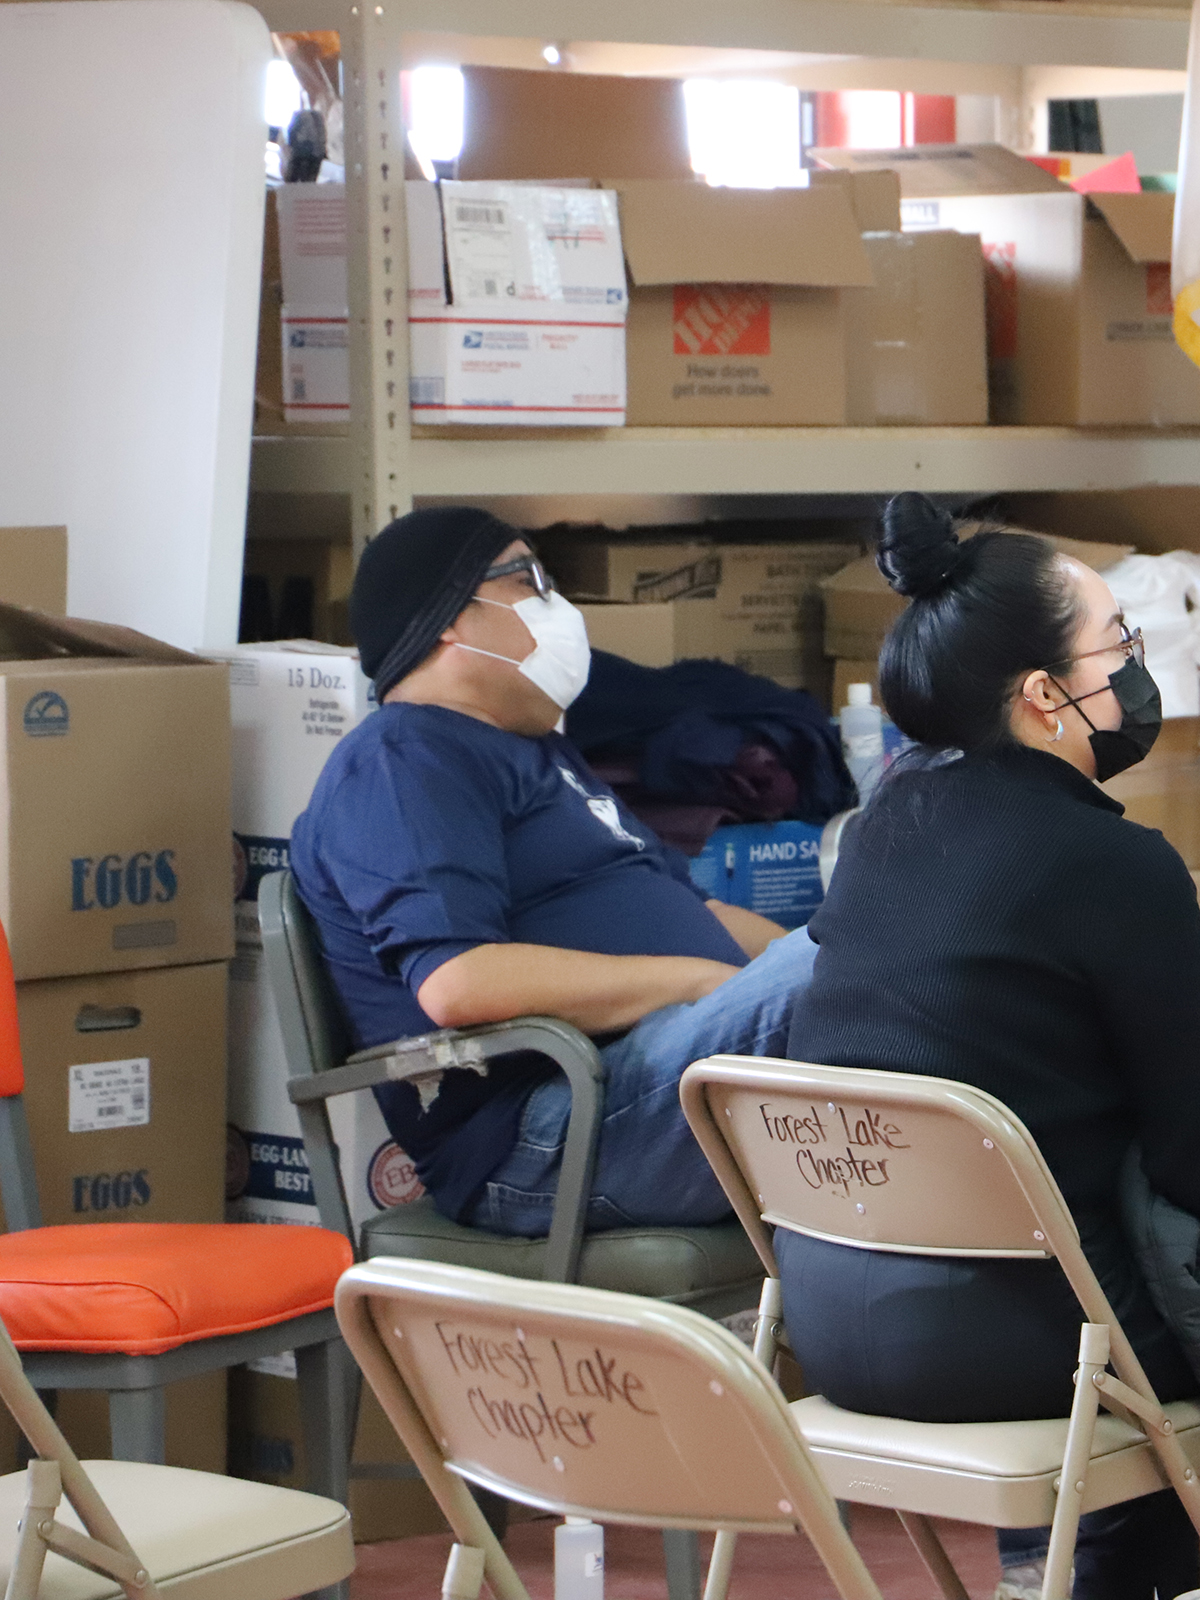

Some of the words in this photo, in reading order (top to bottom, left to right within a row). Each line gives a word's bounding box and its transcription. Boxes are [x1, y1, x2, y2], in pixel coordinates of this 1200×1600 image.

[288, 667, 305, 688] 15
[310, 666, 346, 689] Doz.
[249, 846, 290, 868] EGG-L
[750, 842, 797, 862] HAND
[798, 840, 821, 859] SA
[71, 849, 178, 911] EGGS
[759, 1103, 828, 1144] Forest
[839, 1107, 911, 1149] Lake
[72, 1169, 150, 1213] EGGS
[274, 1169, 310, 1192] BEST
[796, 1147, 890, 1199] Chapter
[435, 1320, 541, 1389] Forest
[551, 1339, 659, 1417] Lake
[467, 1386, 596, 1463] Chapter
